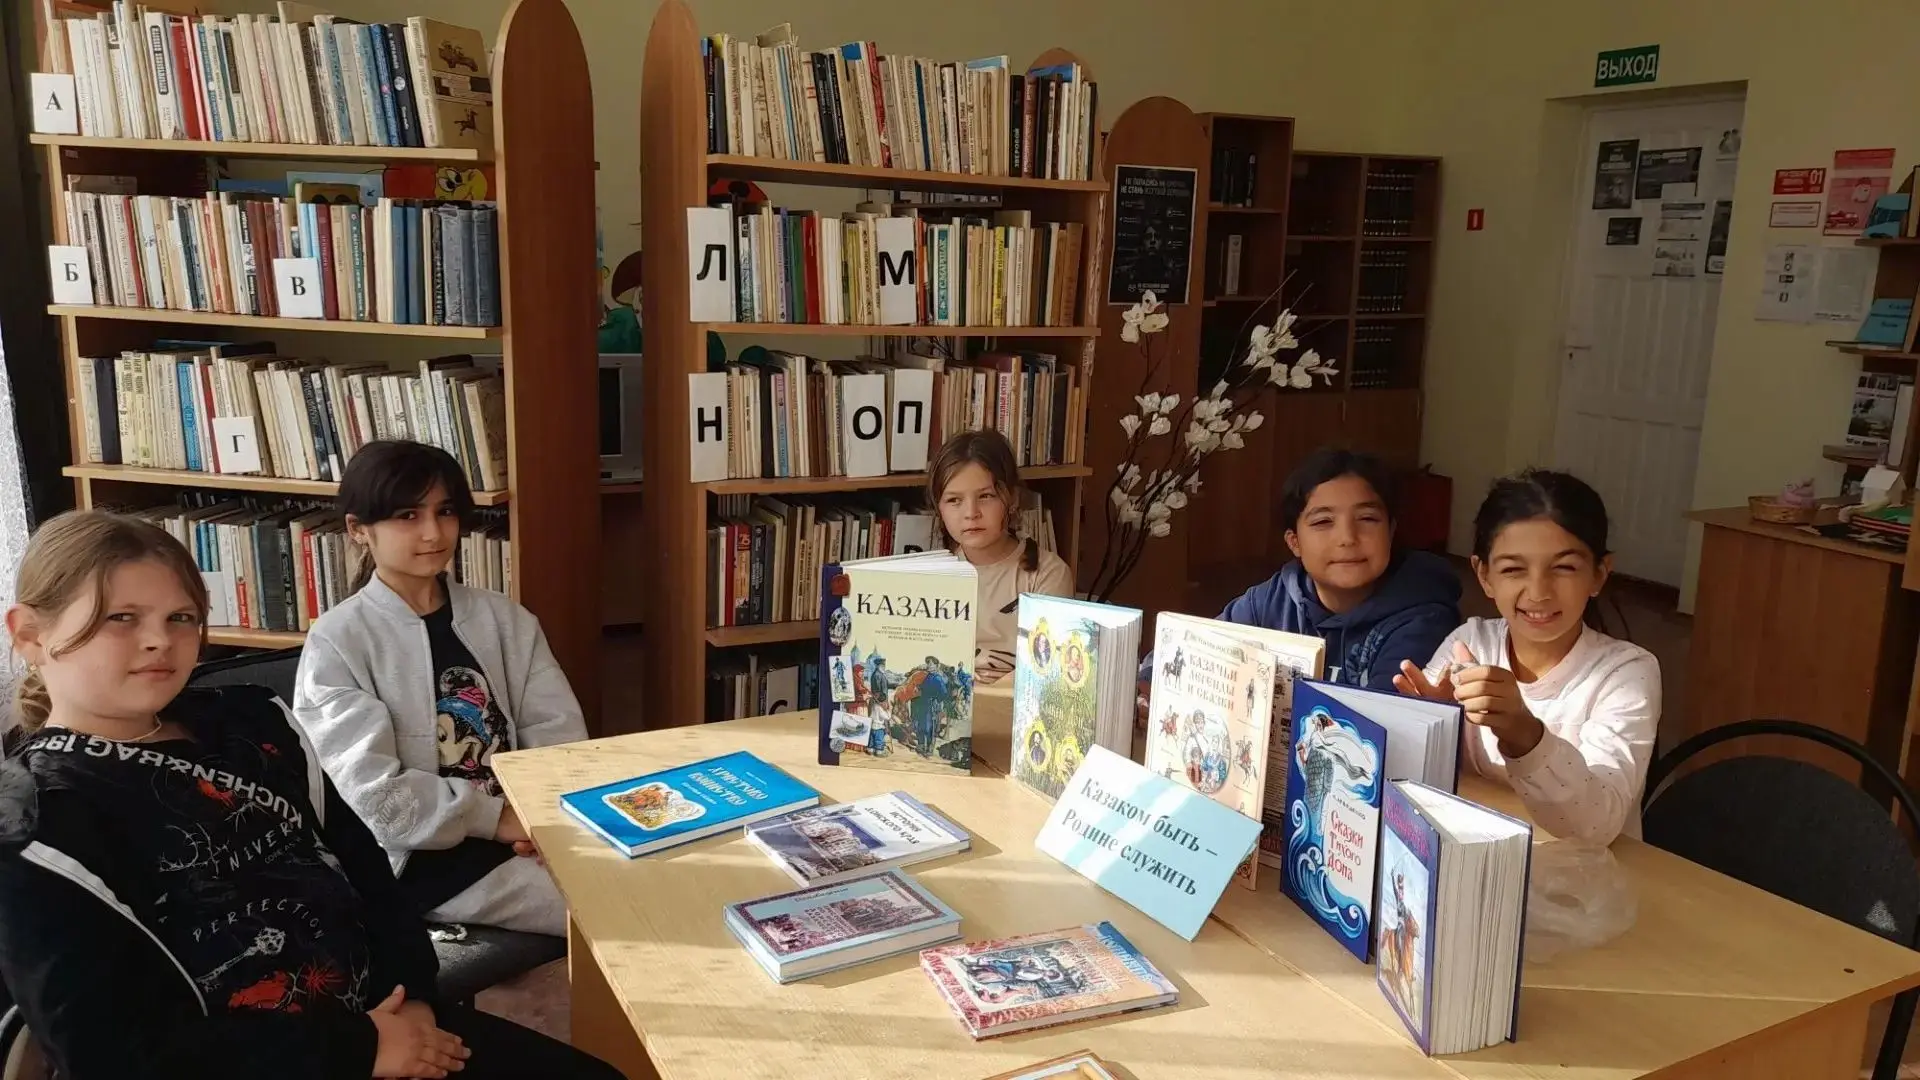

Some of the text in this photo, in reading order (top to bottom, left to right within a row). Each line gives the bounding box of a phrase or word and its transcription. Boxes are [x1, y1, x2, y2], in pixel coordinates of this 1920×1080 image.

[1597, 52, 1657, 81] ВЫХОД
[46, 91, 62, 110] А
[1809, 169, 1823, 185] 01
[64, 262, 79, 282] Б
[697, 244, 727, 281] Л
[879, 250, 915, 287] М
[290, 275, 306, 296] В
[698, 406, 722, 442] Н
[853, 405, 883, 441] О
[898, 401, 923, 434] П
[232, 434, 245, 453] Г
[857, 593, 971, 621] КАЗАКИ
[1188, 669, 1236, 696] ЛЕГЕНДЫ
[1189, 653, 1238, 682] КАЗАЧЬИ
[1196, 685, 1235, 711] СКАЗКИ
[1080, 778, 1152, 827] Казаком
[1153, 815, 1200, 854] быть
[1331, 810, 1364, 850] Сказки
[1062, 808, 1198, 896] Родине служить
[1329, 831, 1362, 866] Тихого
[193, 899, 325, 942] PERFECTION
